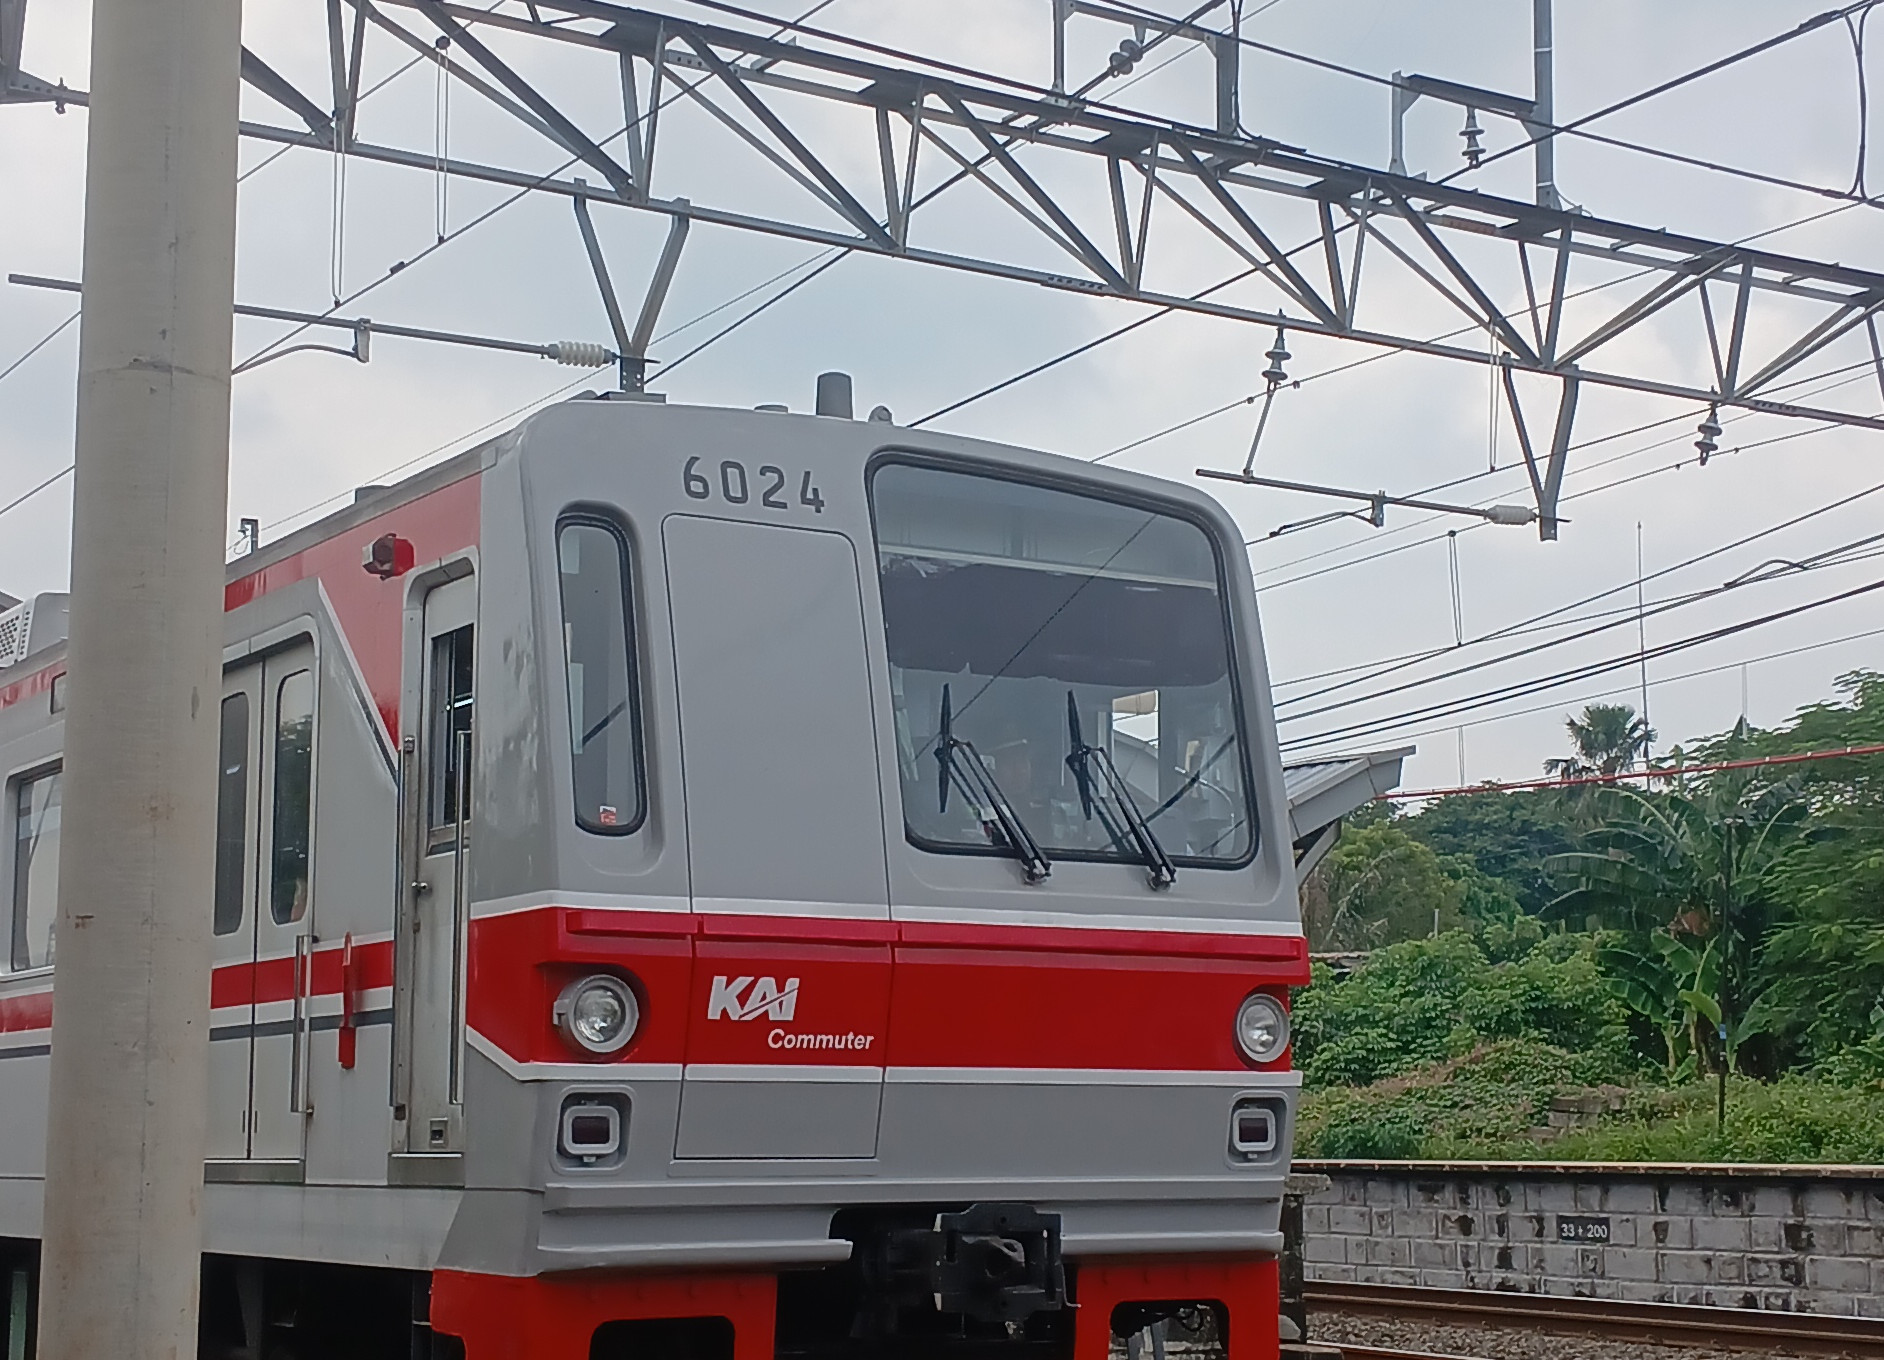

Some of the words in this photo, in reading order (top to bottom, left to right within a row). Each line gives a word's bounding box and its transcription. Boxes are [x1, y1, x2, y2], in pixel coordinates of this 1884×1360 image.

[683, 456, 825, 513] 6024
[707, 975, 800, 1021] KAI
[767, 1028, 874, 1050] Commuter
[1561, 1223, 1575, 1237] 33
[1586, 1223, 1608, 1238] 200
